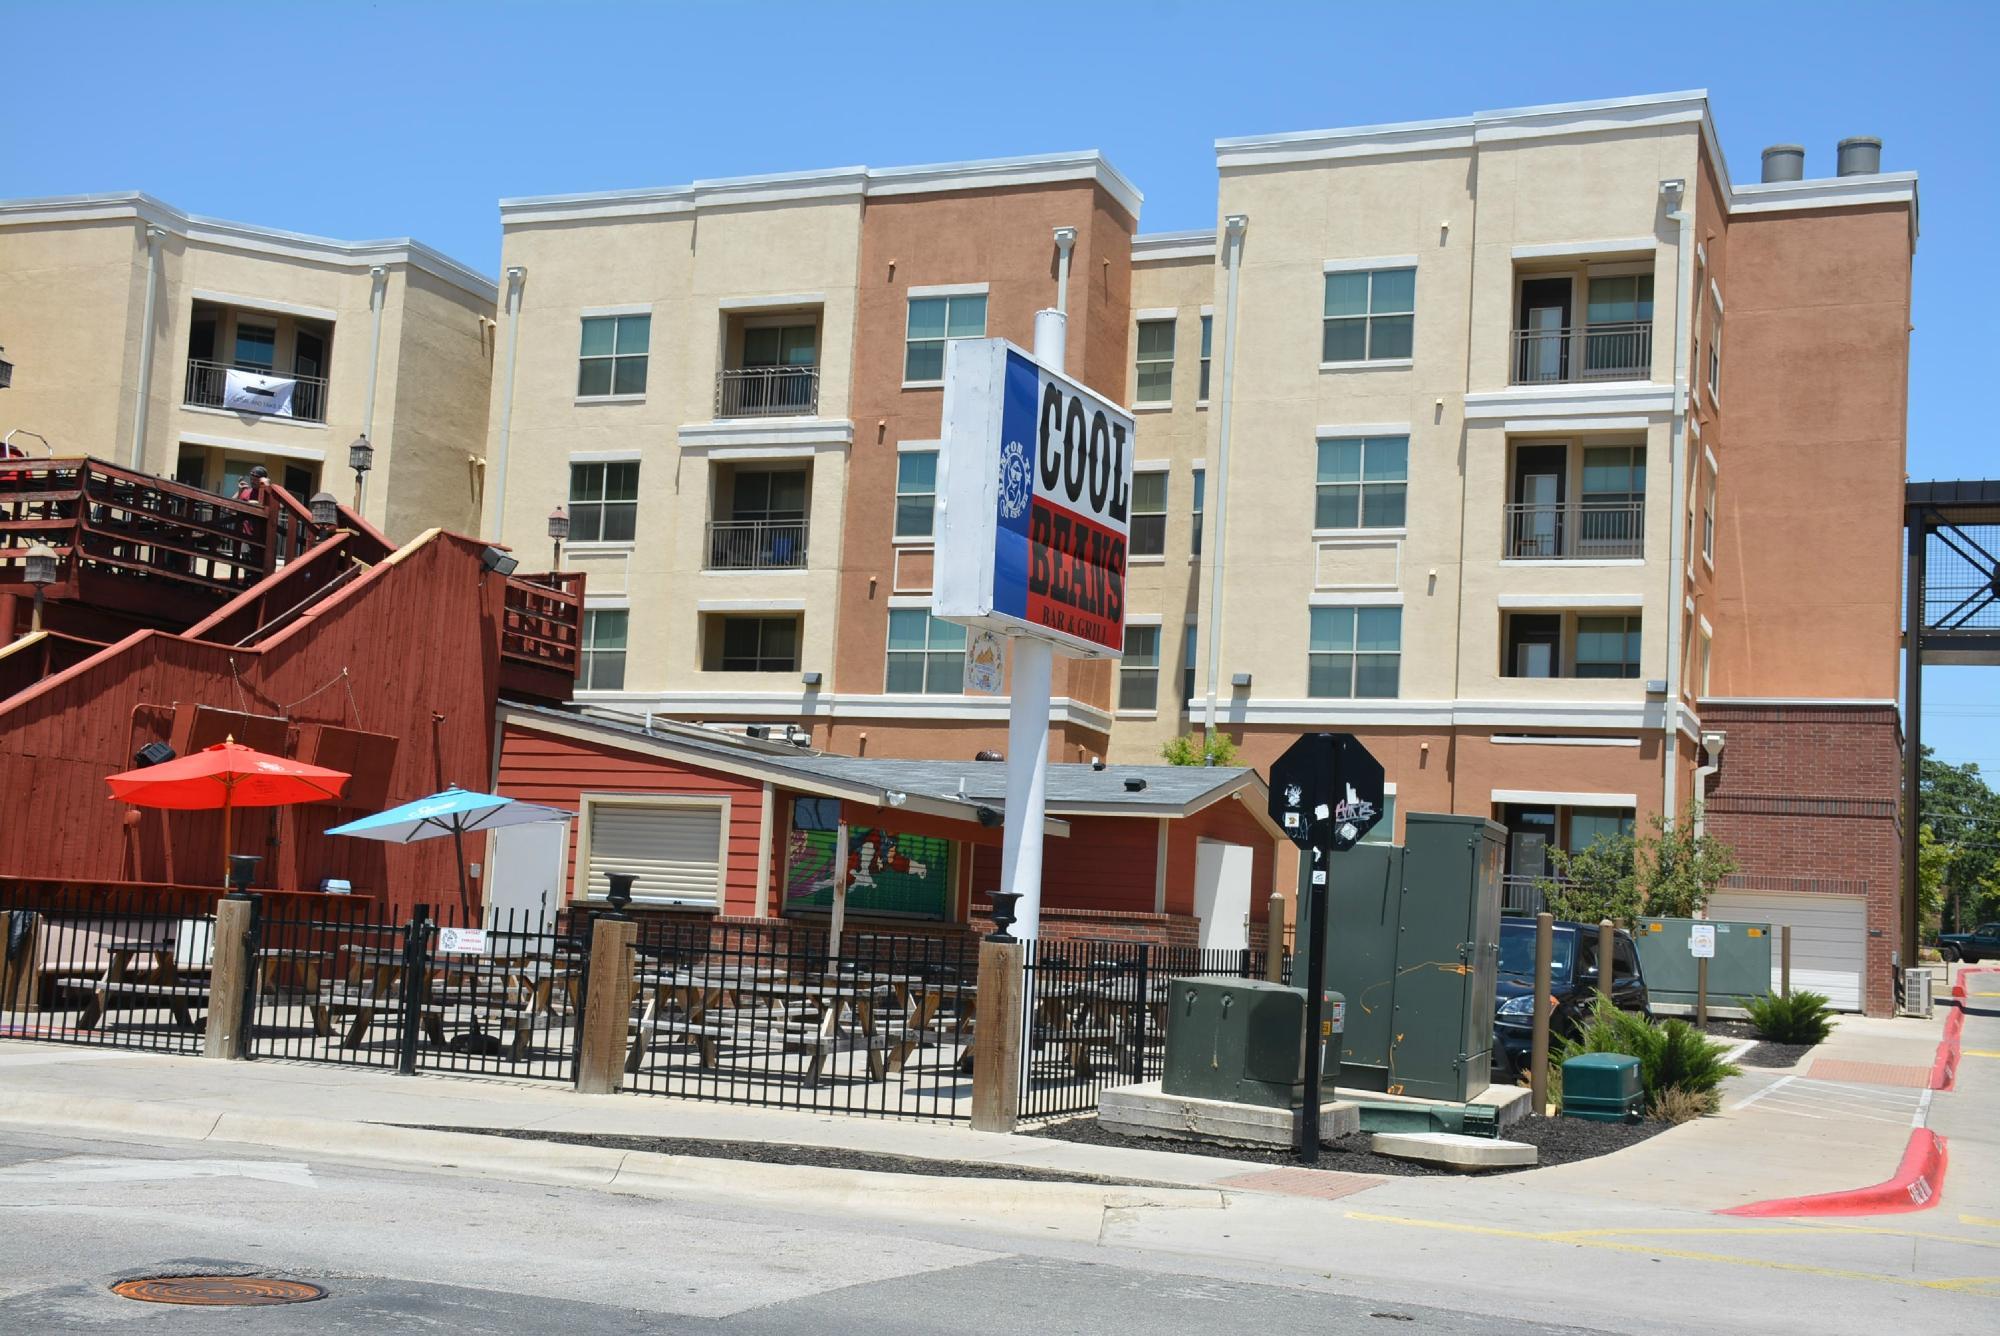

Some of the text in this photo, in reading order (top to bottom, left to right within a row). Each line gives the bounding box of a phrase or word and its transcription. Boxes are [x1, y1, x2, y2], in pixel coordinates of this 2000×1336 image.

[1040, 382, 1129, 524] COOL
[1030, 504, 1125, 624] BEANS
[1042, 605, 1109, 645] BAR & GRILL
